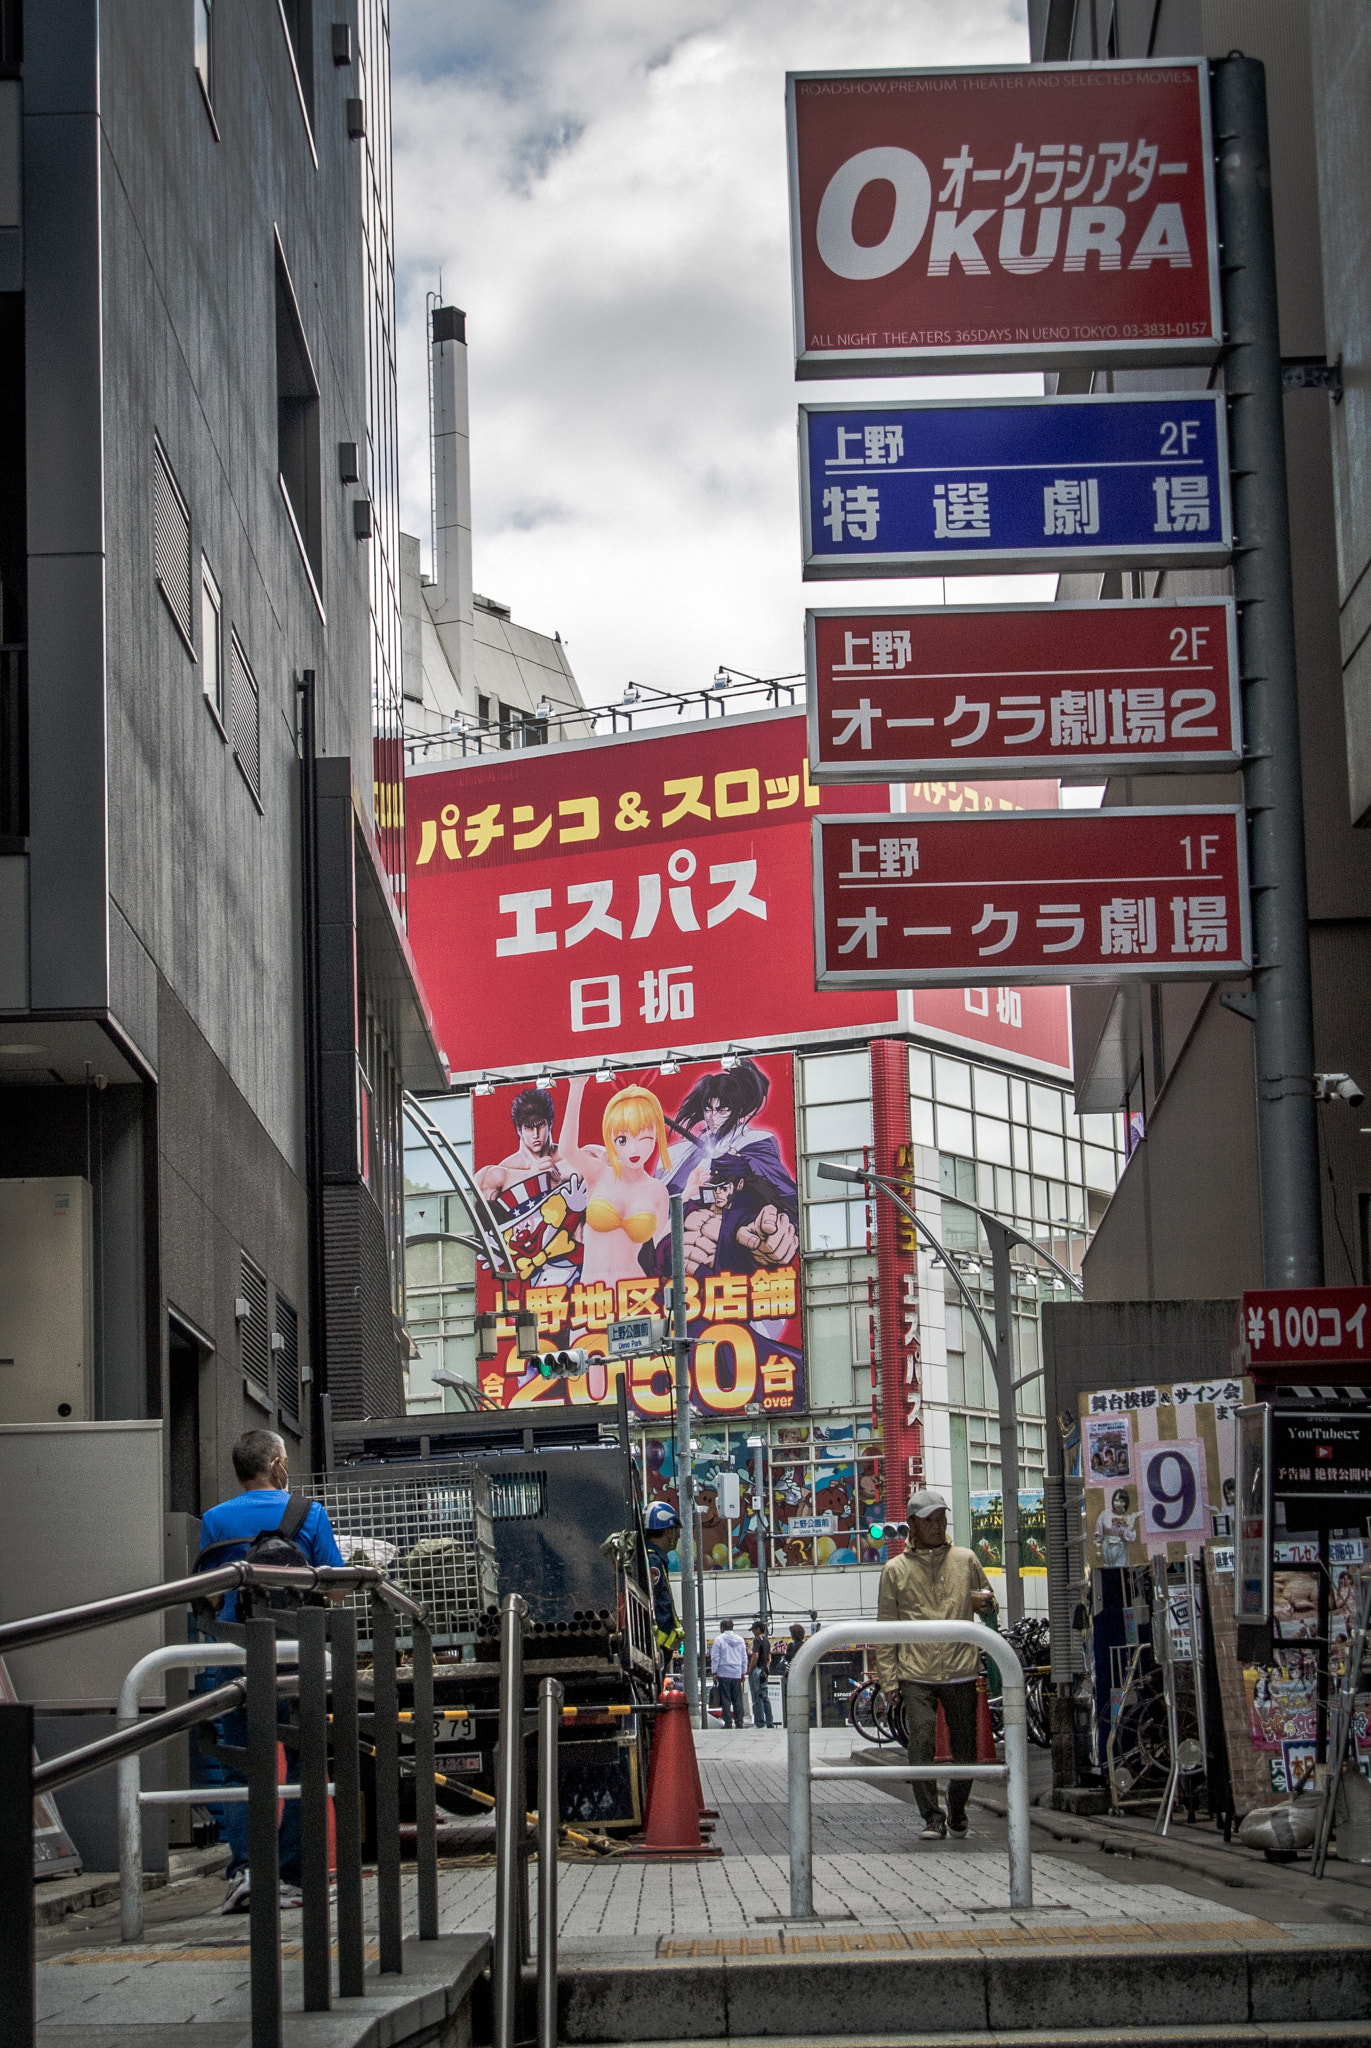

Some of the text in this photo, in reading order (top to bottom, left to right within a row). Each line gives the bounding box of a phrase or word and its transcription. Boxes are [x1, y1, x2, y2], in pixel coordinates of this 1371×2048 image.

[960, 76, 1024, 91] THEATER
[1026, 74, 1060, 88] AND
[1062, 72, 1133, 88] SELECTED
[939, 138, 1188, 207] オークラシアター
[816, 146, 1193, 280] OKURA
[811, 333, 834, 347] ALL
[837, 331, 878, 346] NIGHT
[883, 330, 951, 345] THEATERS
[955, 328, 1012, 343] 365DAYS
[1015, 327, 1029, 341] IN
[1032, 326, 1070, 340] UENO
[1122, 322, 1207, 338] 03-3831-0157
[825, 421, 1200, 466] 上野 2F
[832, 626, 1210, 671] 上野 2F
[831, 688, 1219, 750] オークラ劇場2
[415, 796, 600, 866] パチンコ
[614, 790, 651, 832] &
[838, 835, 1219, 879] 上野 1F
[495, 848, 768, 957] エスパス
[837, 896, 1228, 959] オークラ劇場
[570, 965, 695, 1032] 日拓
[612, 1322, 648, 1341] 上野公園前
[619, 1339, 642, 1350] Ueno Park
[903, 1273, 924, 1427] エスパス
[761, 1355, 797, 1395] 台
[763, 1395, 794, 1408] over
[1288, 1427, 1360, 1440] YouTubeにて
[1147, 1450, 1196, 1529] 9
[793, 1518, 829, 1529] 上野公園前
